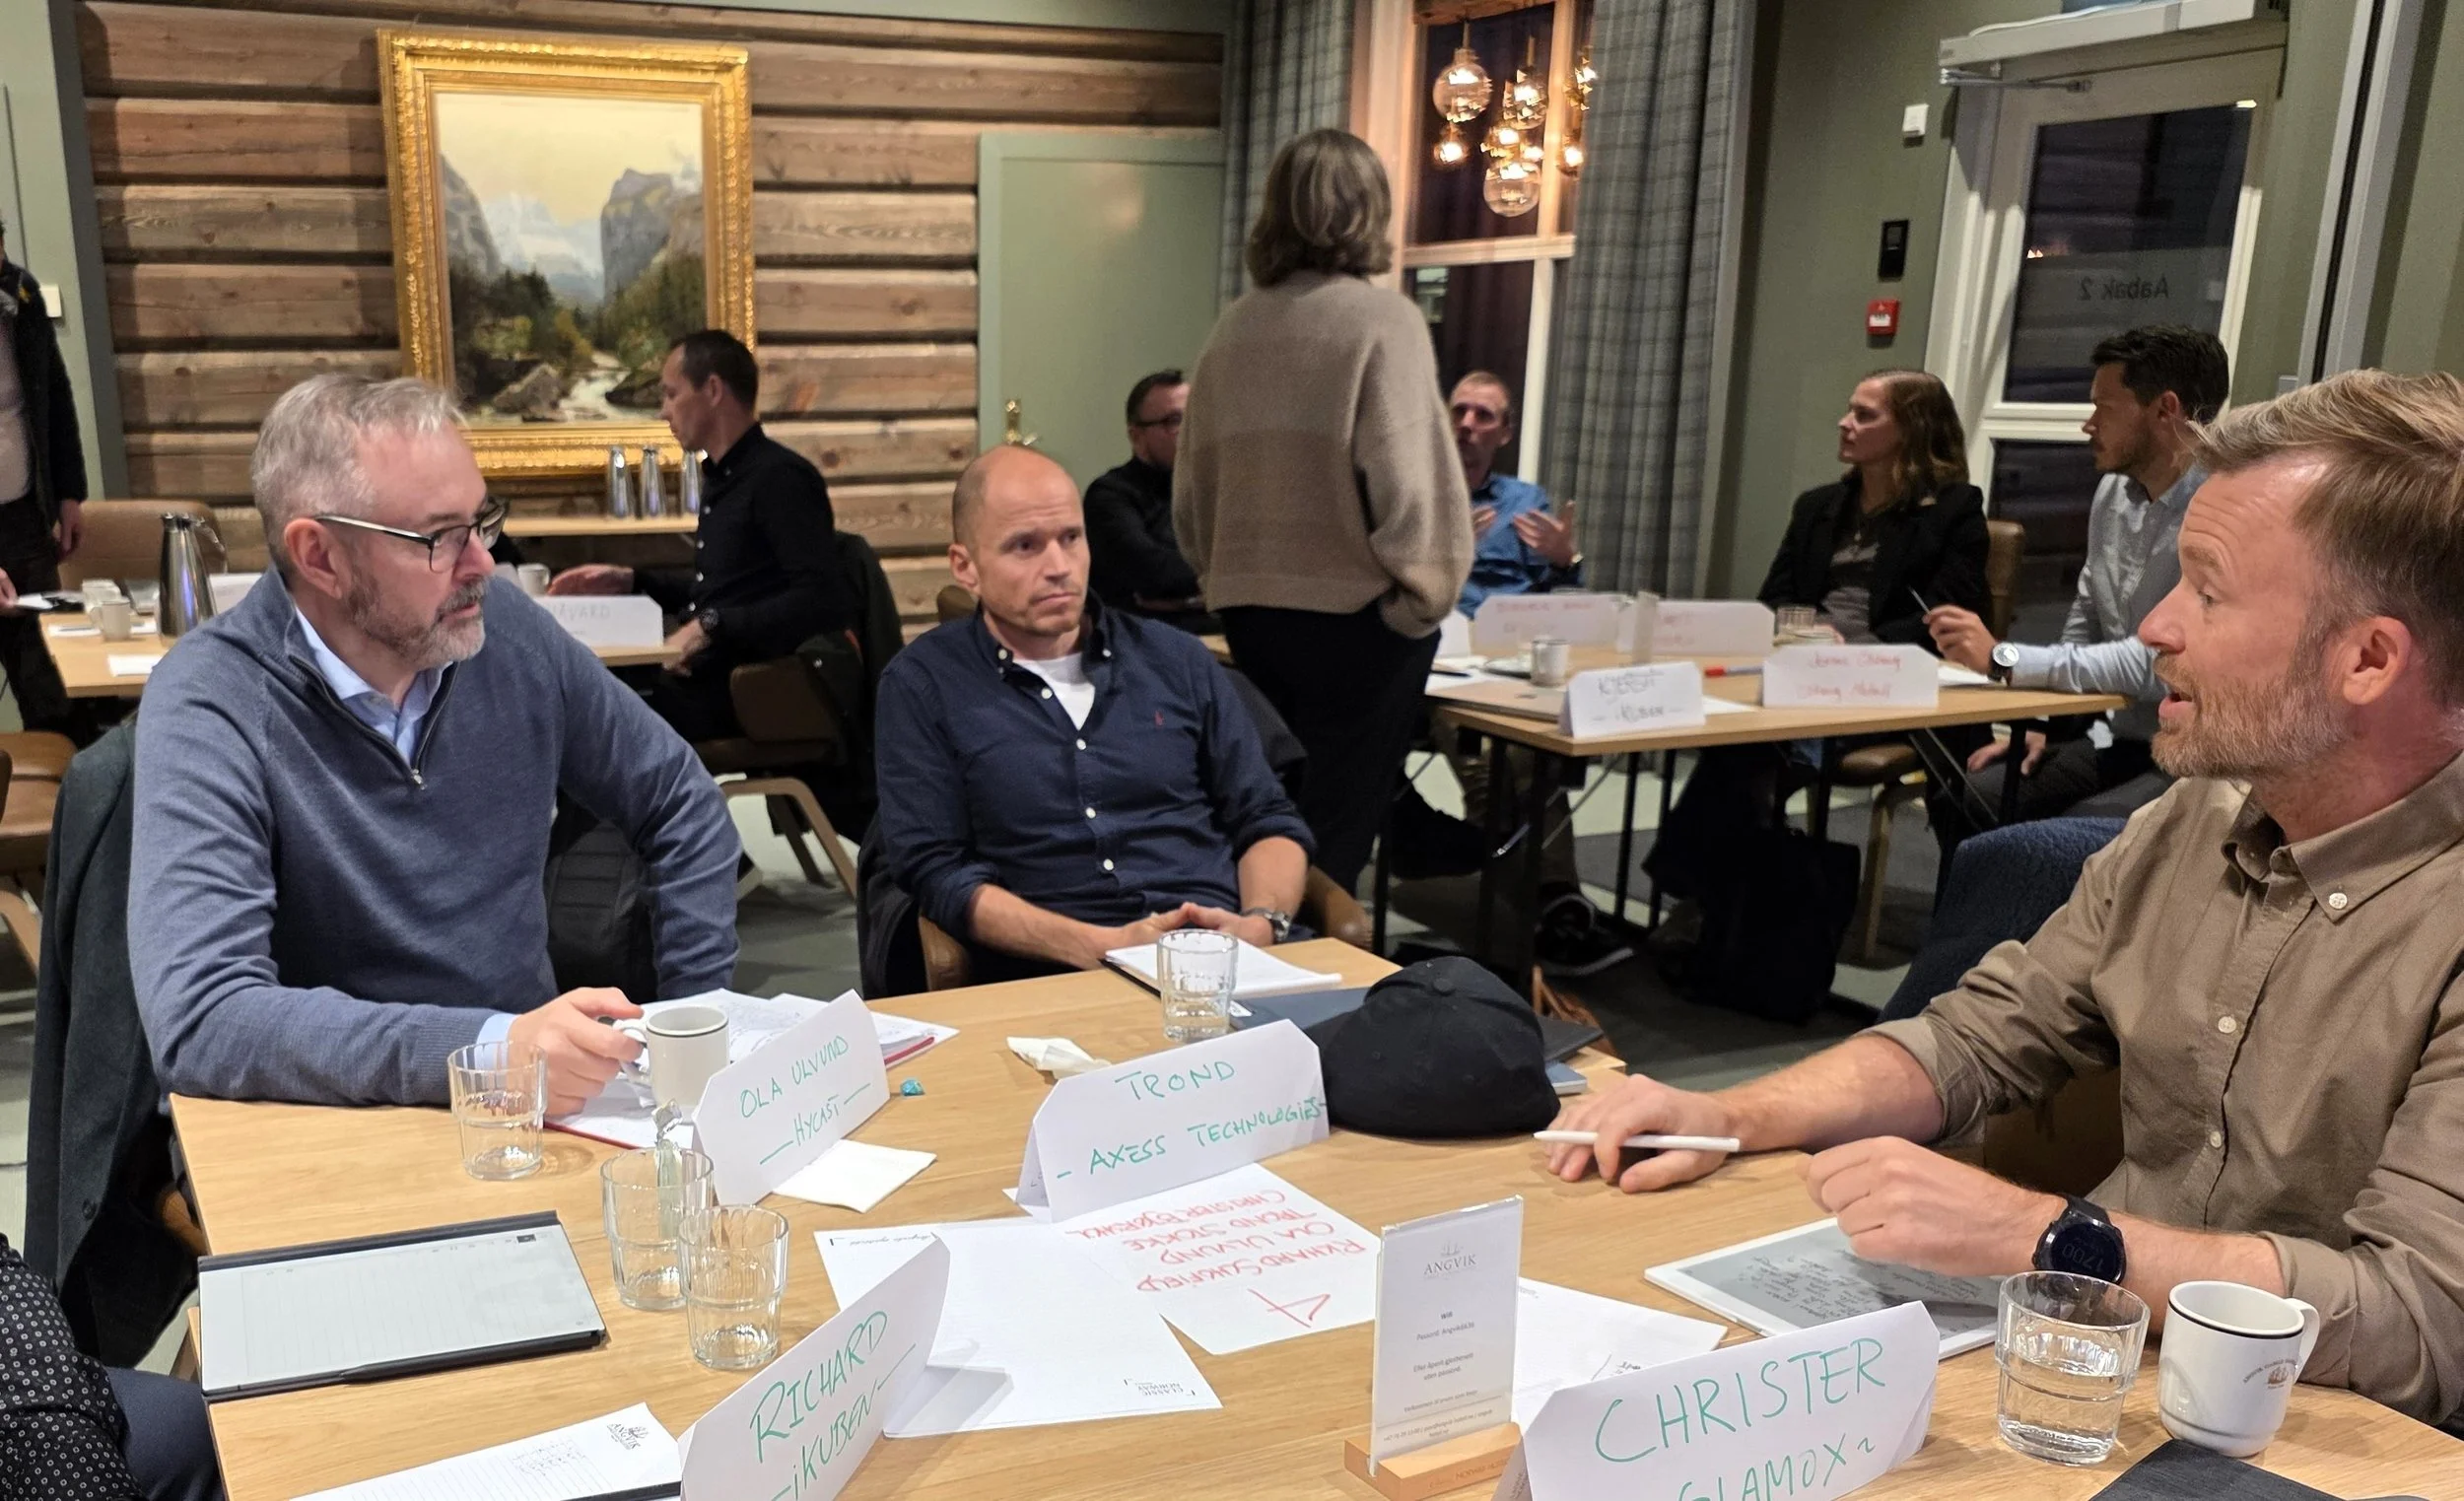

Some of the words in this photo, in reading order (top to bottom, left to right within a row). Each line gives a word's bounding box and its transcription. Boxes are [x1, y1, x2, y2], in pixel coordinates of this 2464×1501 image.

[740, 1076, 784, 1119] OLA
[791, 1035, 850, 1085] ULVUND
[1115, 1060, 1236, 1100] TROND
[794, 1094, 840, 1146] HYCAST
[1089, 1134, 1167, 1175] AXESS
[1187, 1095, 1323, 1147] TECHNOLOGIES
[1123, 1223, 1226, 1252] STOKKE
[1229, 1208, 1317, 1229] TROND
[1273, 1221, 1335, 1240] OLA
[1159, 1234, 1274, 1264] ULVUND
[1423, 1254, 1476, 1275] ANGVIK
[749, 1310, 889, 1464] RICHARD
[1595, 1336, 1886, 1464] CHRISTER
[791, 1379, 879, 1501] iKUBEN
